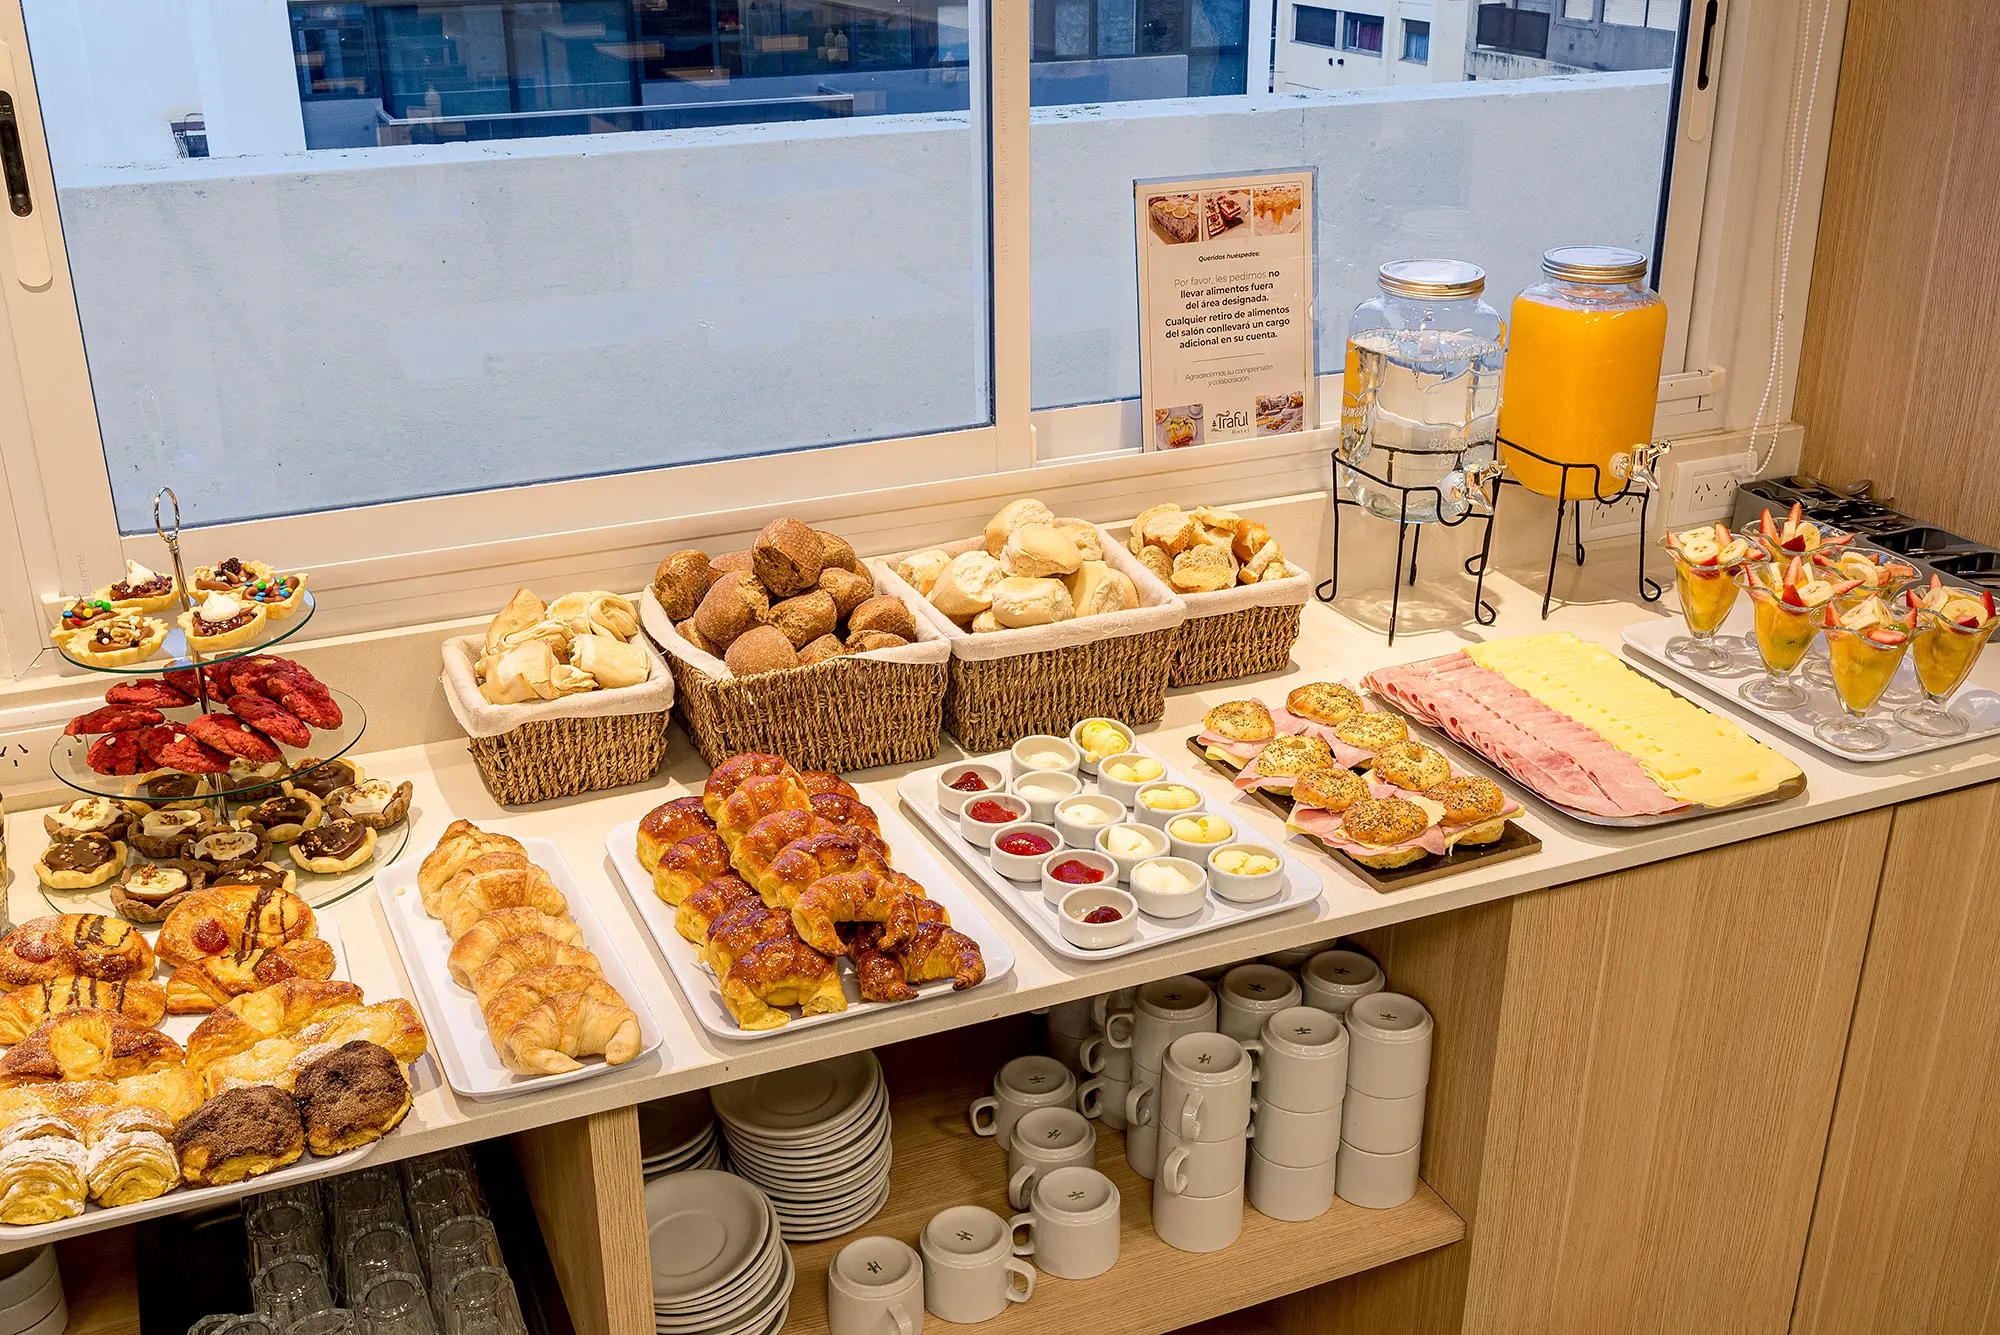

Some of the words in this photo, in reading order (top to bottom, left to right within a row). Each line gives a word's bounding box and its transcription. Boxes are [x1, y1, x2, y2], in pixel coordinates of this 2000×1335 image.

[1198, 254, 1225, 262] Queridos
[1227, 251, 1260, 260] huéspedes:
[1175, 278, 1188, 287] Por
[1191, 276, 1213, 286] favor,
[1215, 274, 1227, 283] les
[1229, 272, 1266, 283] pedimos
[1180, 289, 1204, 298] llevar
[1206, 285, 1249, 296] alimentos
[1251, 283, 1273, 291] fuera
[1186, 301, 1199, 310] del
[1201, 298, 1220, 308] área
[1222, 294, 1269, 306] designada.
[1165, 315, 1207, 327] Cualquier
[1209, 312, 1232, 322] retiro
[1234, 310, 1245, 319] de
[1247, 307, 1289, 317] alimentos
[1166, 329, 1179, 338] del
[1181, 326, 1204, 337] salón
[1206, 322, 1250, 334] conllevará
[1253, 321, 1263, 329] un
[1265, 318, 1290, 329] cargo
[1180, 337, 1219, 349] adicional
[1221, 336, 1231, 344] en
[1246, 331, 1278, 341] cuenta.
[1186, 371, 1226, 380] Agradecemos
[1235, 365, 1273, 375] comprensión
[1216, 411, 1249, 429] Traful
